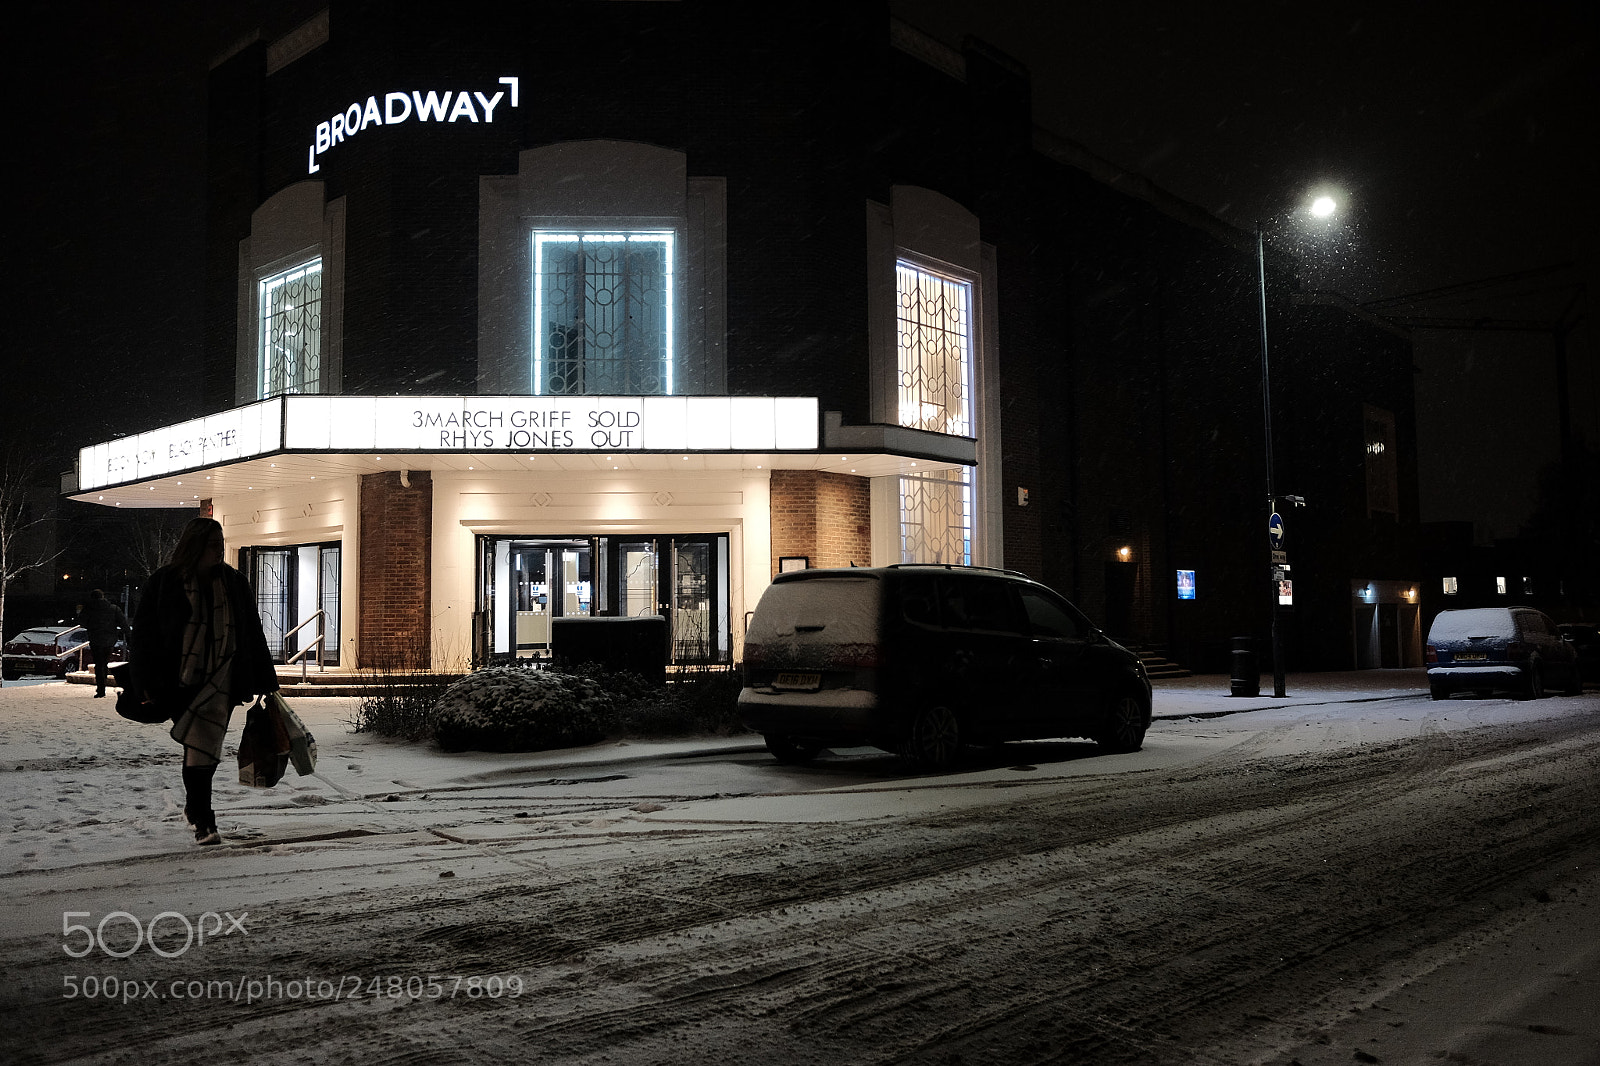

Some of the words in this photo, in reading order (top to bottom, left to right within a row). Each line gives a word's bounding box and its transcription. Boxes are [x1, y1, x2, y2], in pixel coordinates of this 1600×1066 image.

[316, 90, 505, 155] BROADWAY
[511, 411, 572, 428] GRIFF
[588, 411, 640, 428] SOLD
[440, 430, 494, 447] RHYS
[505, 430, 573, 447] JONES
[591, 430, 633, 447] OUT
